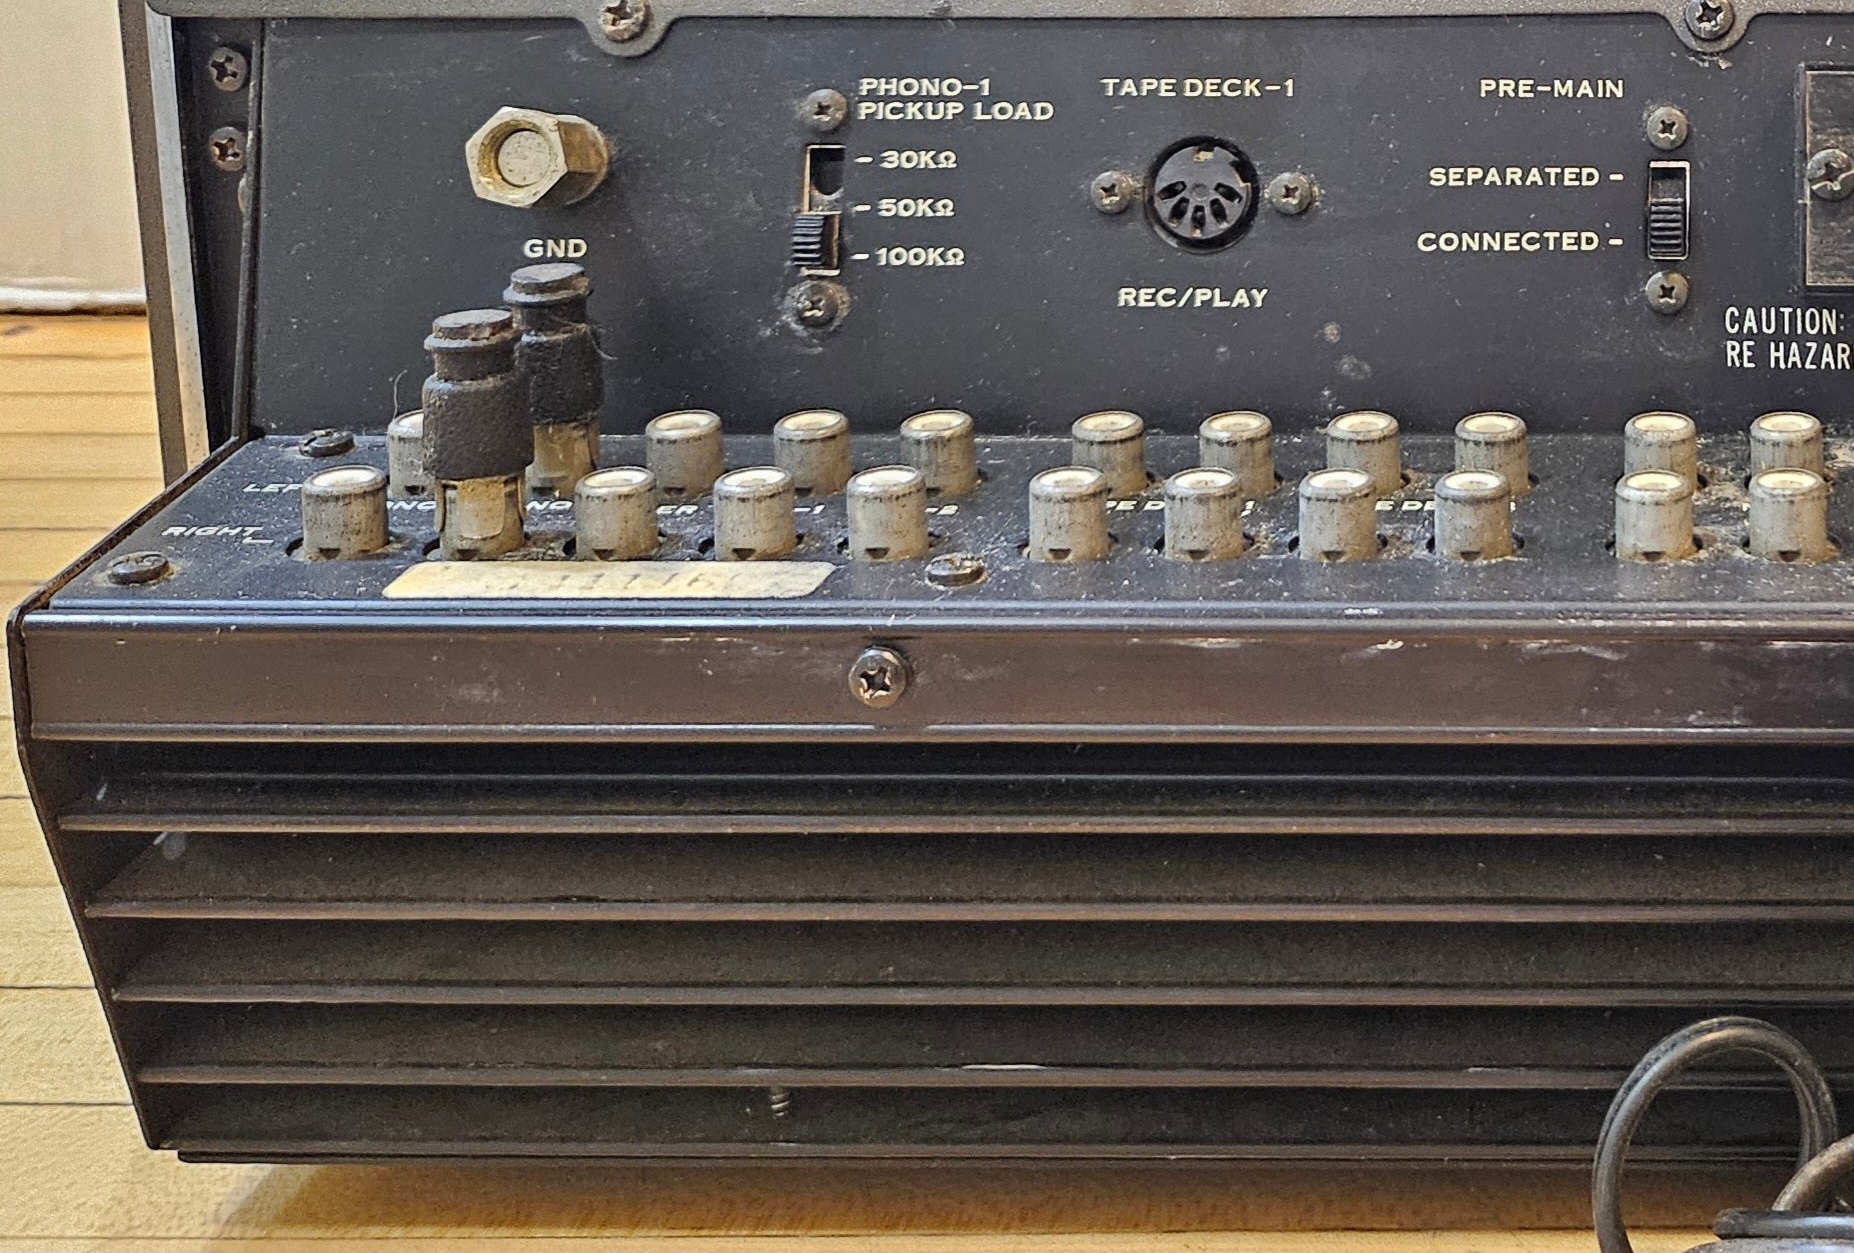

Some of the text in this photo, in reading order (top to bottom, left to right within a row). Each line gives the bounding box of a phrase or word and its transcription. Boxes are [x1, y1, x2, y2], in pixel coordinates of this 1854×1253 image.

[858, 77, 990, 97] PHONO-1
[1099, 78, 1294, 97] TAPE DECK-1
[1480, 79, 1624, 98] PRE-MAIN
[857, 101, 1054, 121] PICKUP LOAD
[879, 150, 958, 169] 30KΩ
[1429, 167, 1600, 187] SEPARATED
[877, 198, 955, 217] 50KΩ
[523, 238, 588, 259] GND
[1417, 231, 1599, 252] CONNECTED
[875, 246, 965, 267] 100KΩ
[1117, 287, 1268, 308] REC/PLAY
[1725, 306, 1844, 335] CAUTION:
[1726, 340, 1756, 368] RE
[161, 525, 265, 537] RIGHT
